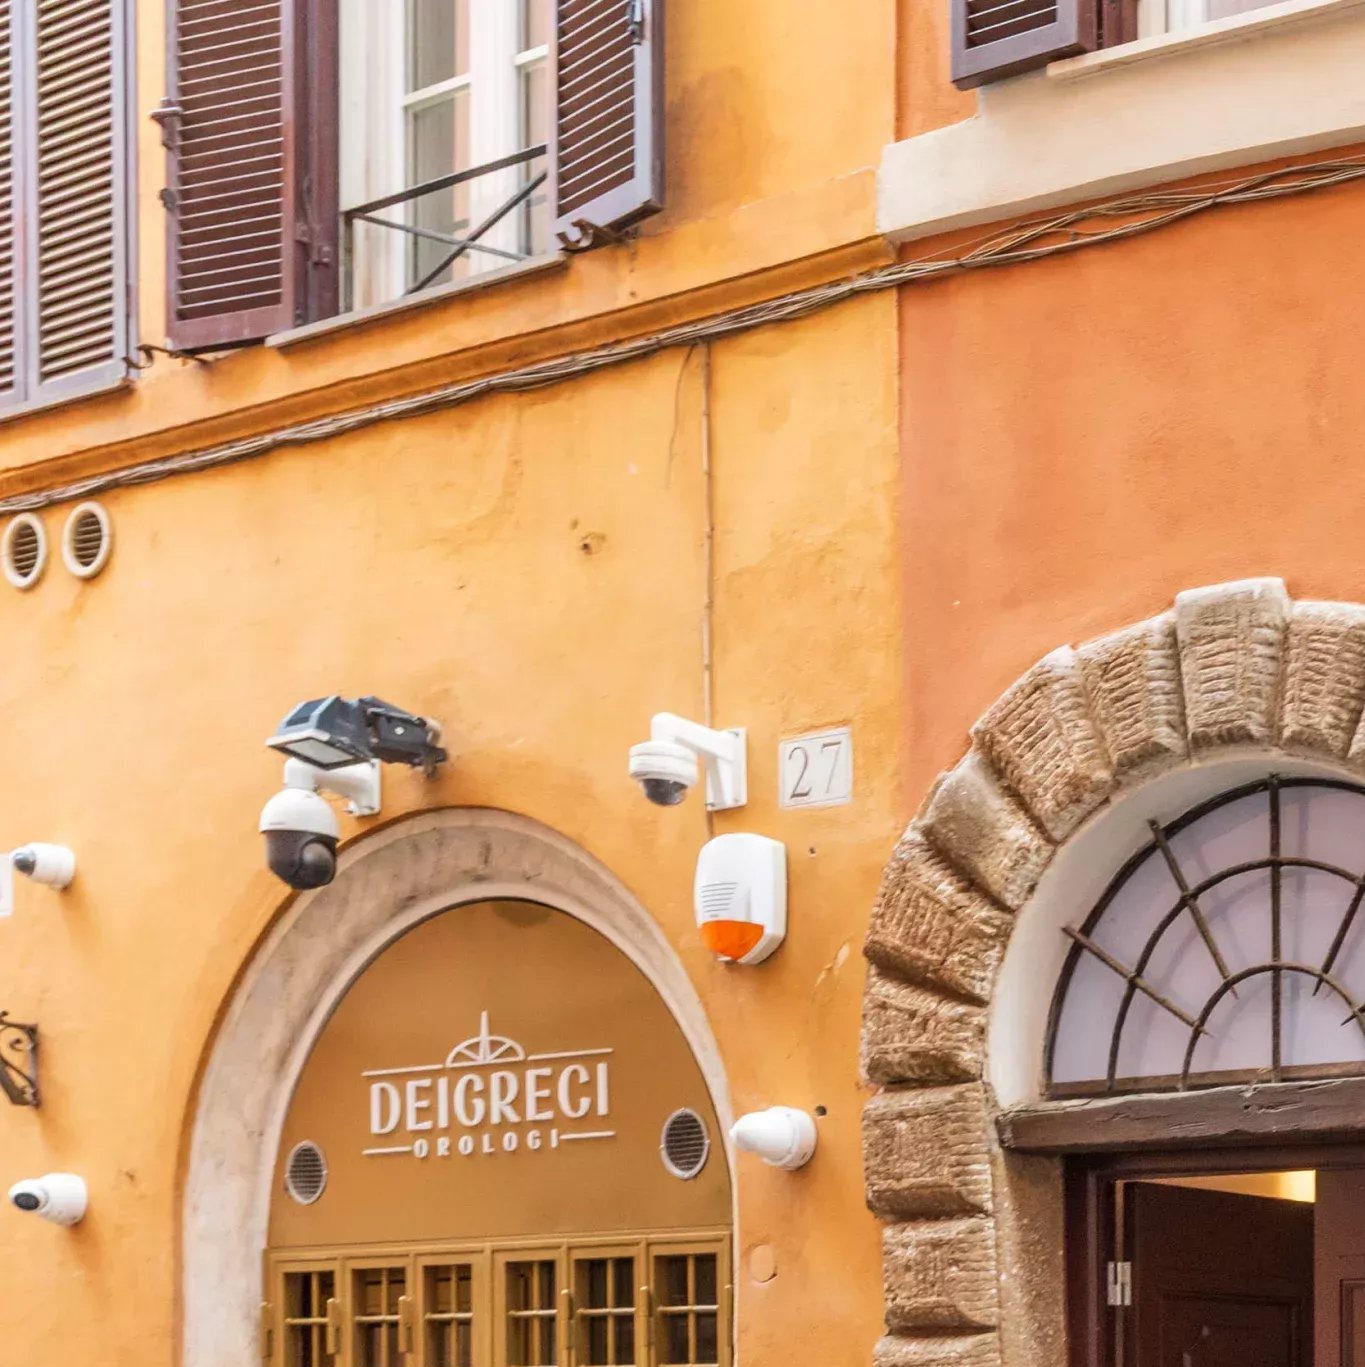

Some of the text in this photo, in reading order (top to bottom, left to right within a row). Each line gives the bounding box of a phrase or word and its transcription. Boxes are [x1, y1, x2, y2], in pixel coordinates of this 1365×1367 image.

[788, 740, 842, 799] 27
[369, 1061, 610, 1135] DEIGRECI
[412, 1127, 560, 1160] OROLOGI
